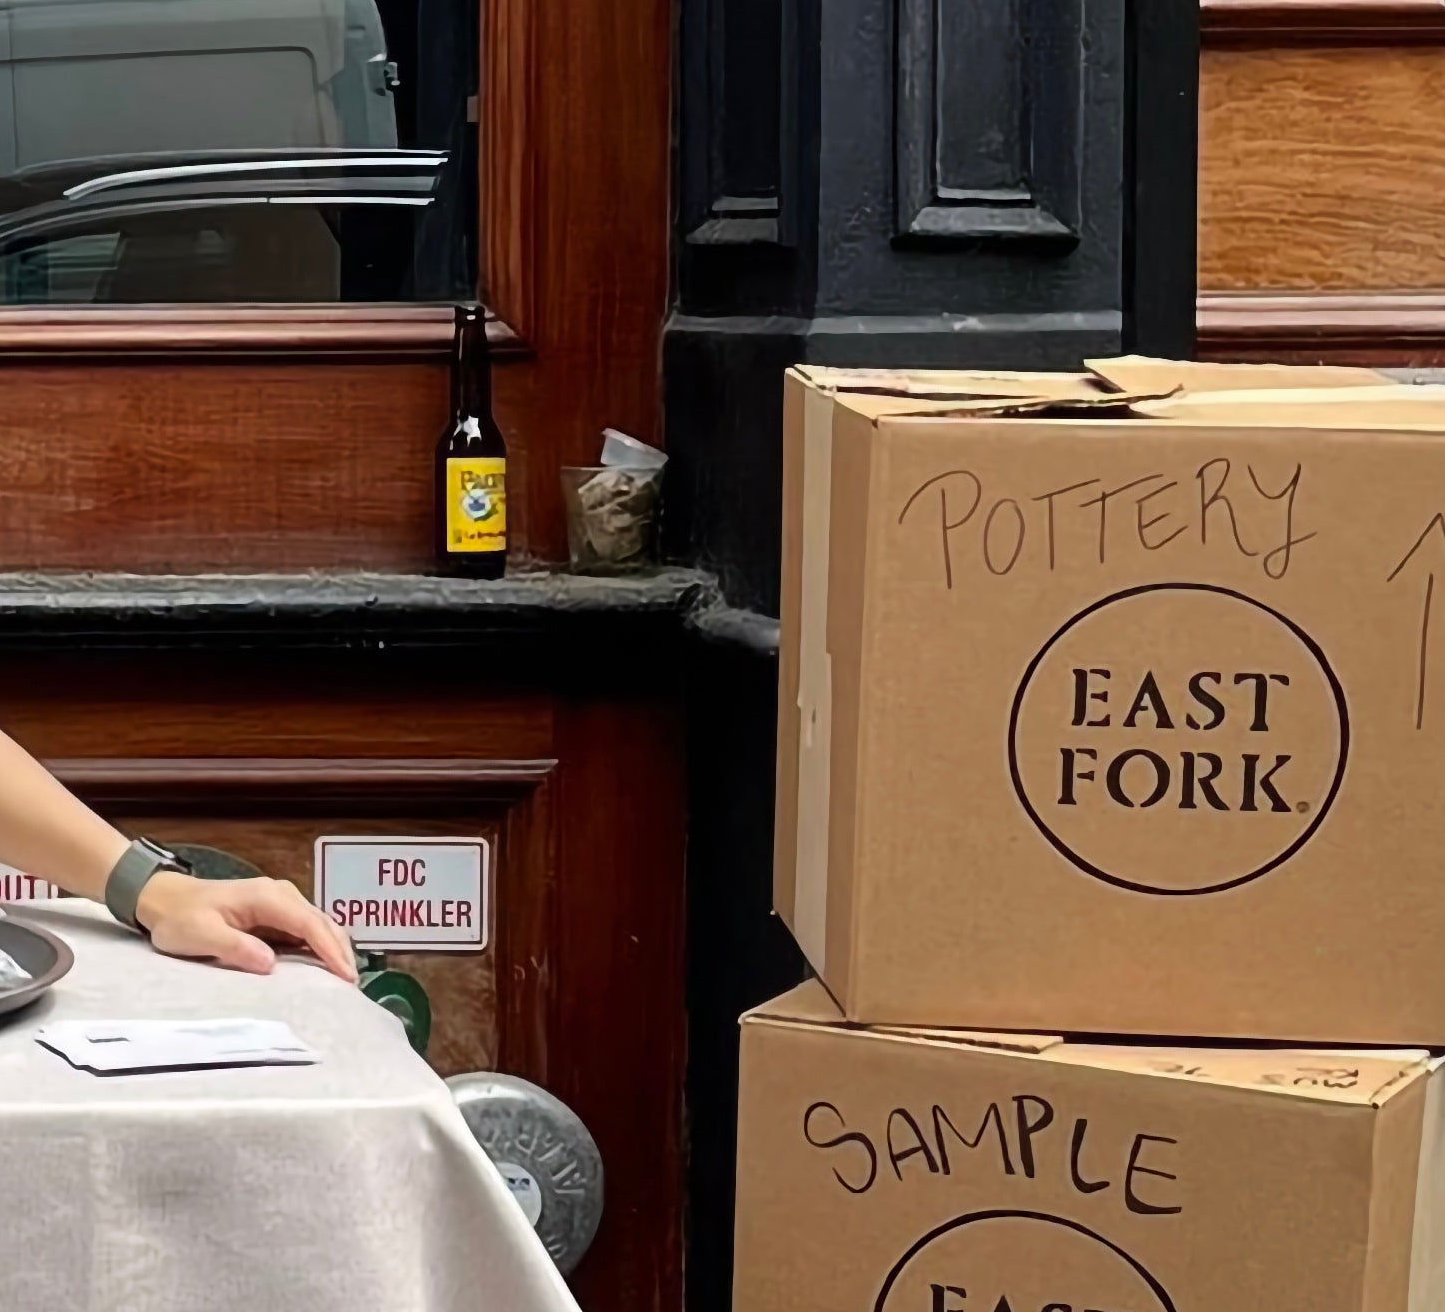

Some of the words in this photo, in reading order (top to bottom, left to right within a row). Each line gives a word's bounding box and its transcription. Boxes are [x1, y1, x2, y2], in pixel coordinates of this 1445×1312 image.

[899, 458, 1317, 590] POTTERY
[1071, 668, 1291, 731] EAST
[378, 858, 426, 887] FDC
[332, 899, 472, 928] SPRINKLER
[803, 1094, 1183, 1215] SAMPLE
